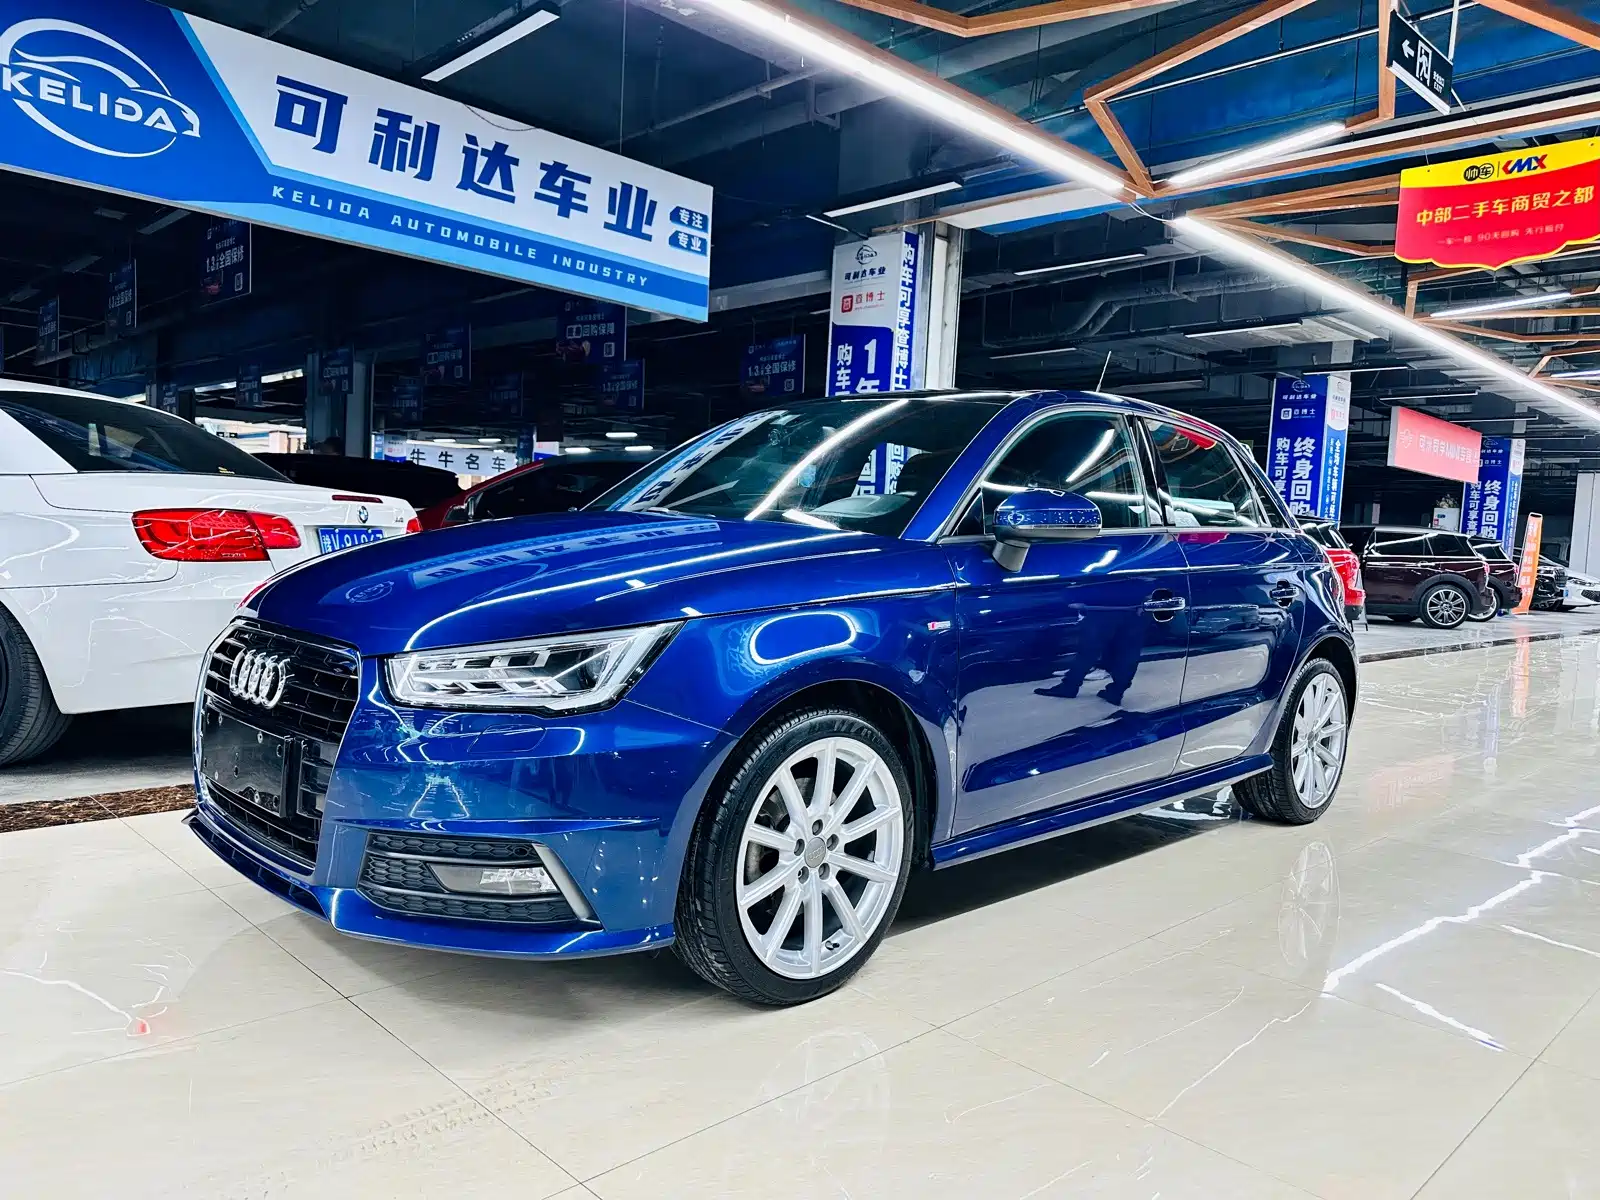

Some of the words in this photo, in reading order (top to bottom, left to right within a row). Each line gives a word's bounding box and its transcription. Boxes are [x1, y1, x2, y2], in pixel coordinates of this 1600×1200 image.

[2, 66, 178, 135] KELIDA
[274, 75, 658, 242] 可利达车业
[272, 185, 371, 219] KELIDA
[390, 213, 537, 260] AUTOMOBILE
[552, 253, 649, 287] INDUSTRY
[679, 208, 704, 229] 专注
[1416, 185, 1595, 227] 中部二手车商贸之都
[678, 232, 702, 252] 专业
[834, 342, 853, 396] 购车
[1273, 437, 1291, 501] 购车可享
[1289, 436, 1316, 516] 终身回购
[1480, 480, 1502, 540] 终身回购
